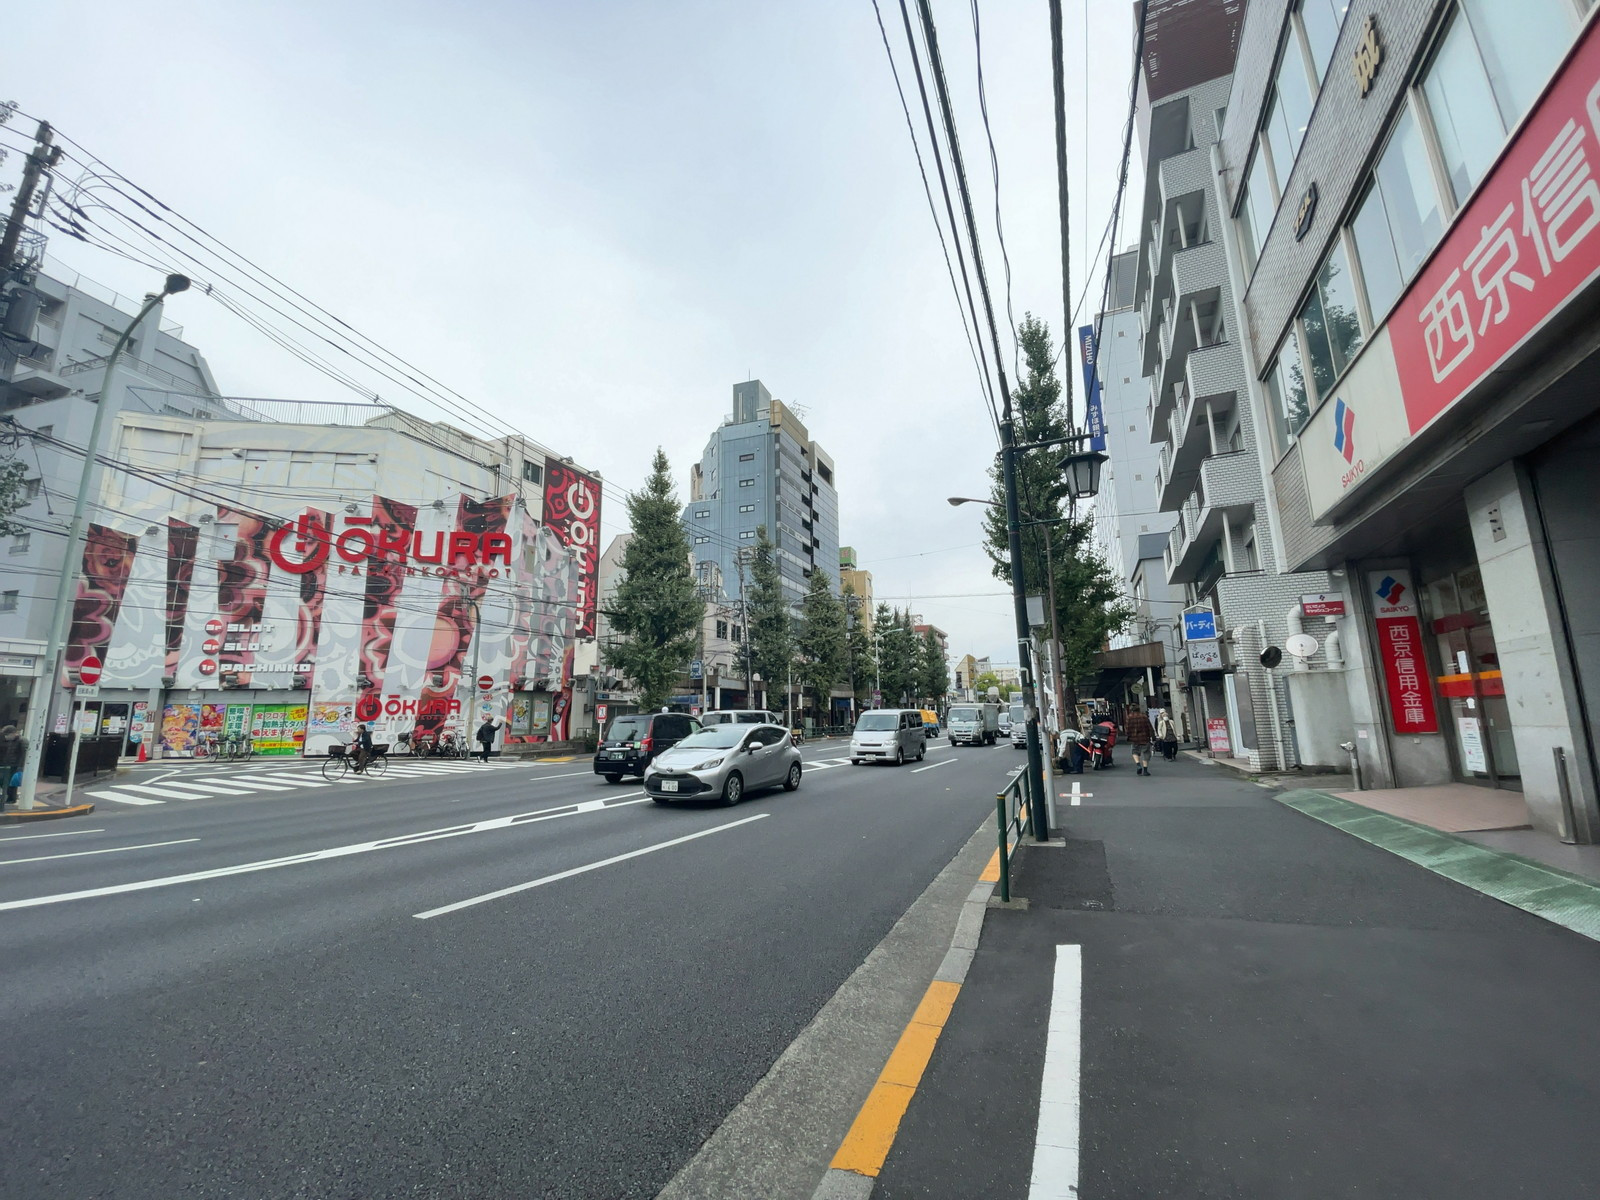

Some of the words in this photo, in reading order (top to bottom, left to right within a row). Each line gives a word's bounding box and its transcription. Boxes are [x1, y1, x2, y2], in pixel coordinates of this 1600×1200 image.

[1418, 77, 1600, 384] 西京信
[1085, 335, 1093, 365] MIZUHO
[1090, 404, 1100, 438] みずほ銀行
[1341, 459, 1364, 488] SAIKYO
[1380, 605, 1410, 614] SAIKYO
[227, 623, 275, 633] SLOT
[1186, 619, 1214, 630] バーディー
[224, 642, 272, 652] SLOT
[220, 663, 312, 672] PACHINKO
[1388, 624, 1426, 724] 西京信用金庫
